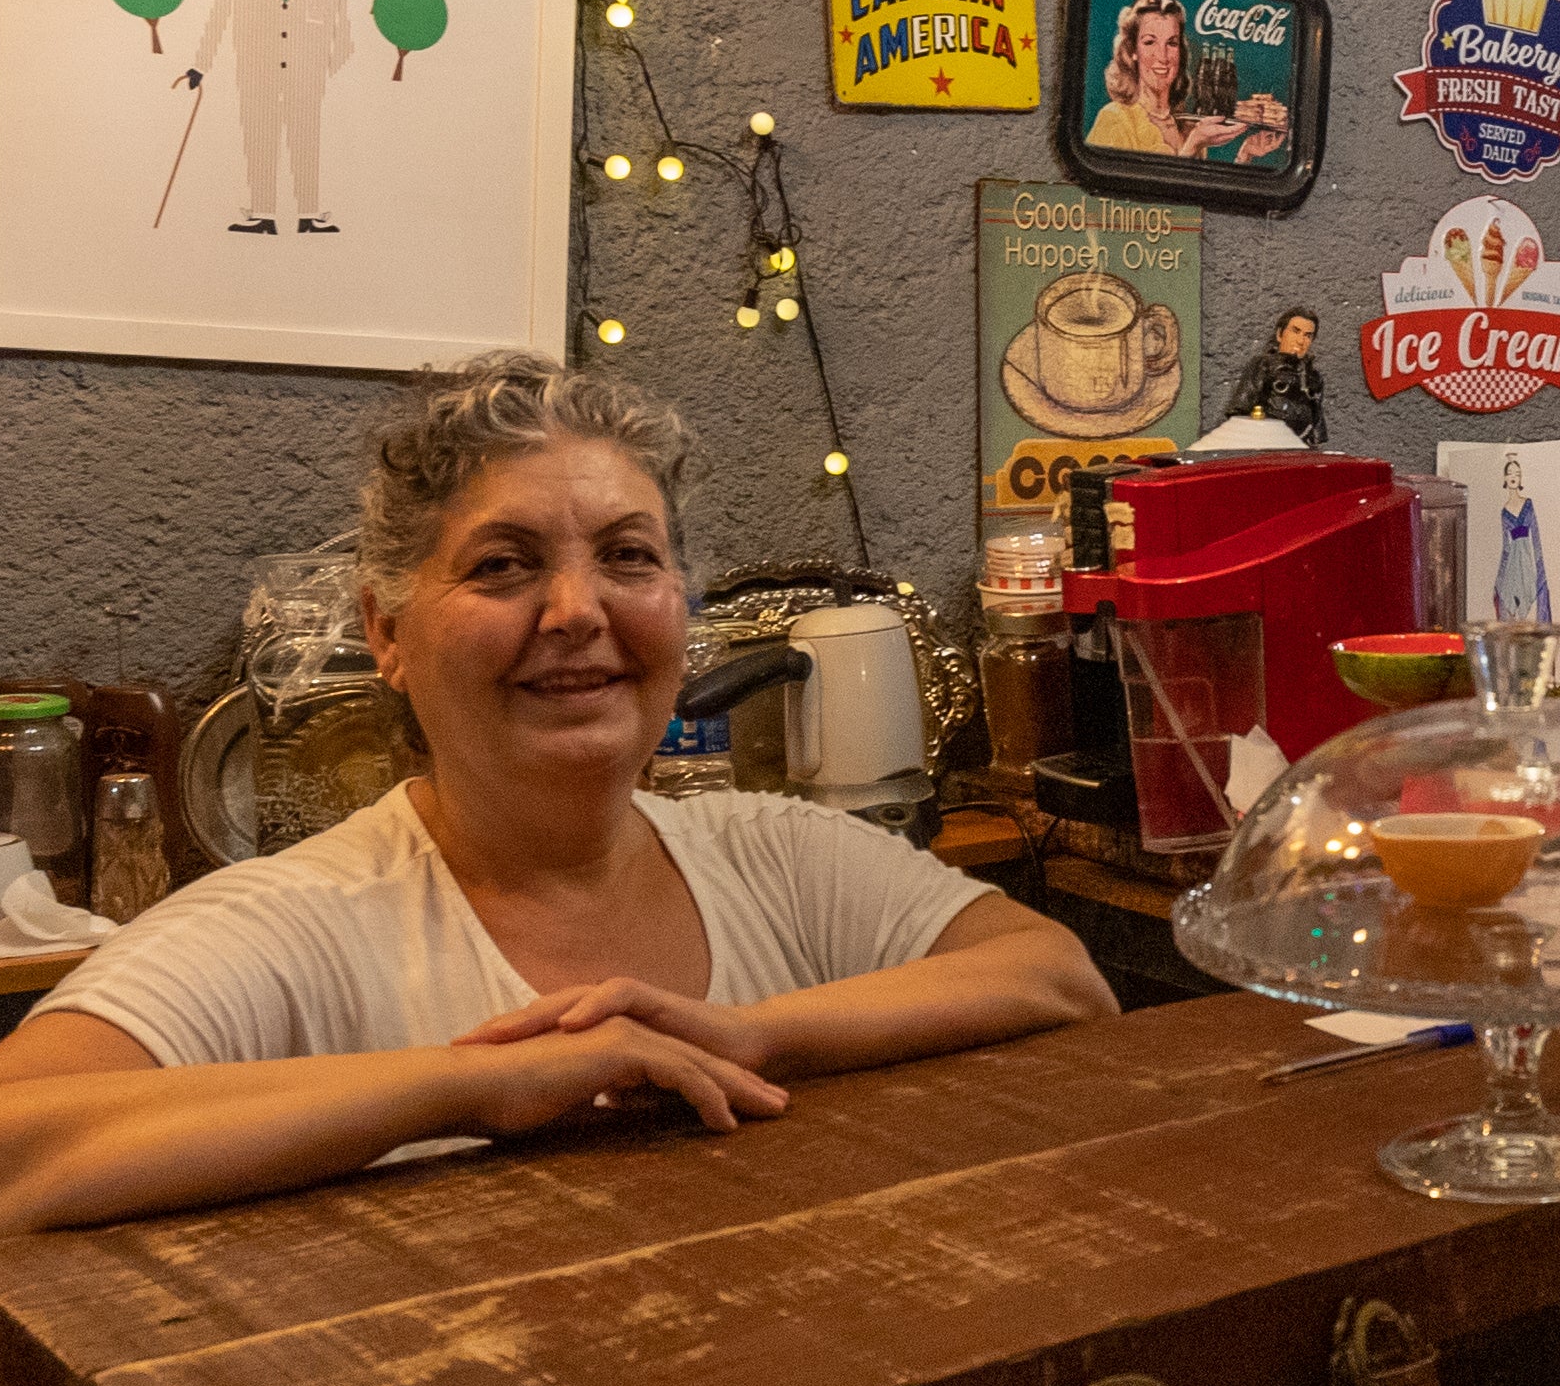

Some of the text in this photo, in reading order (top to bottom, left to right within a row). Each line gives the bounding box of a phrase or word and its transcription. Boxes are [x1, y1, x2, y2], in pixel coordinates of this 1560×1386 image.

[854, 13, 1017, 86] AMERICA
[1437, 78, 1502, 105] FRESH
[1478, 123, 1527, 146] SERVED
[1482, 144, 1521, 164] DAILY
[1014, 192, 1172, 244] Good Things
[1004, 236, 1184, 273] Happen Over
[1394, 284, 1455, 305] delicious
[1372, 319, 1443, 380] Ice
